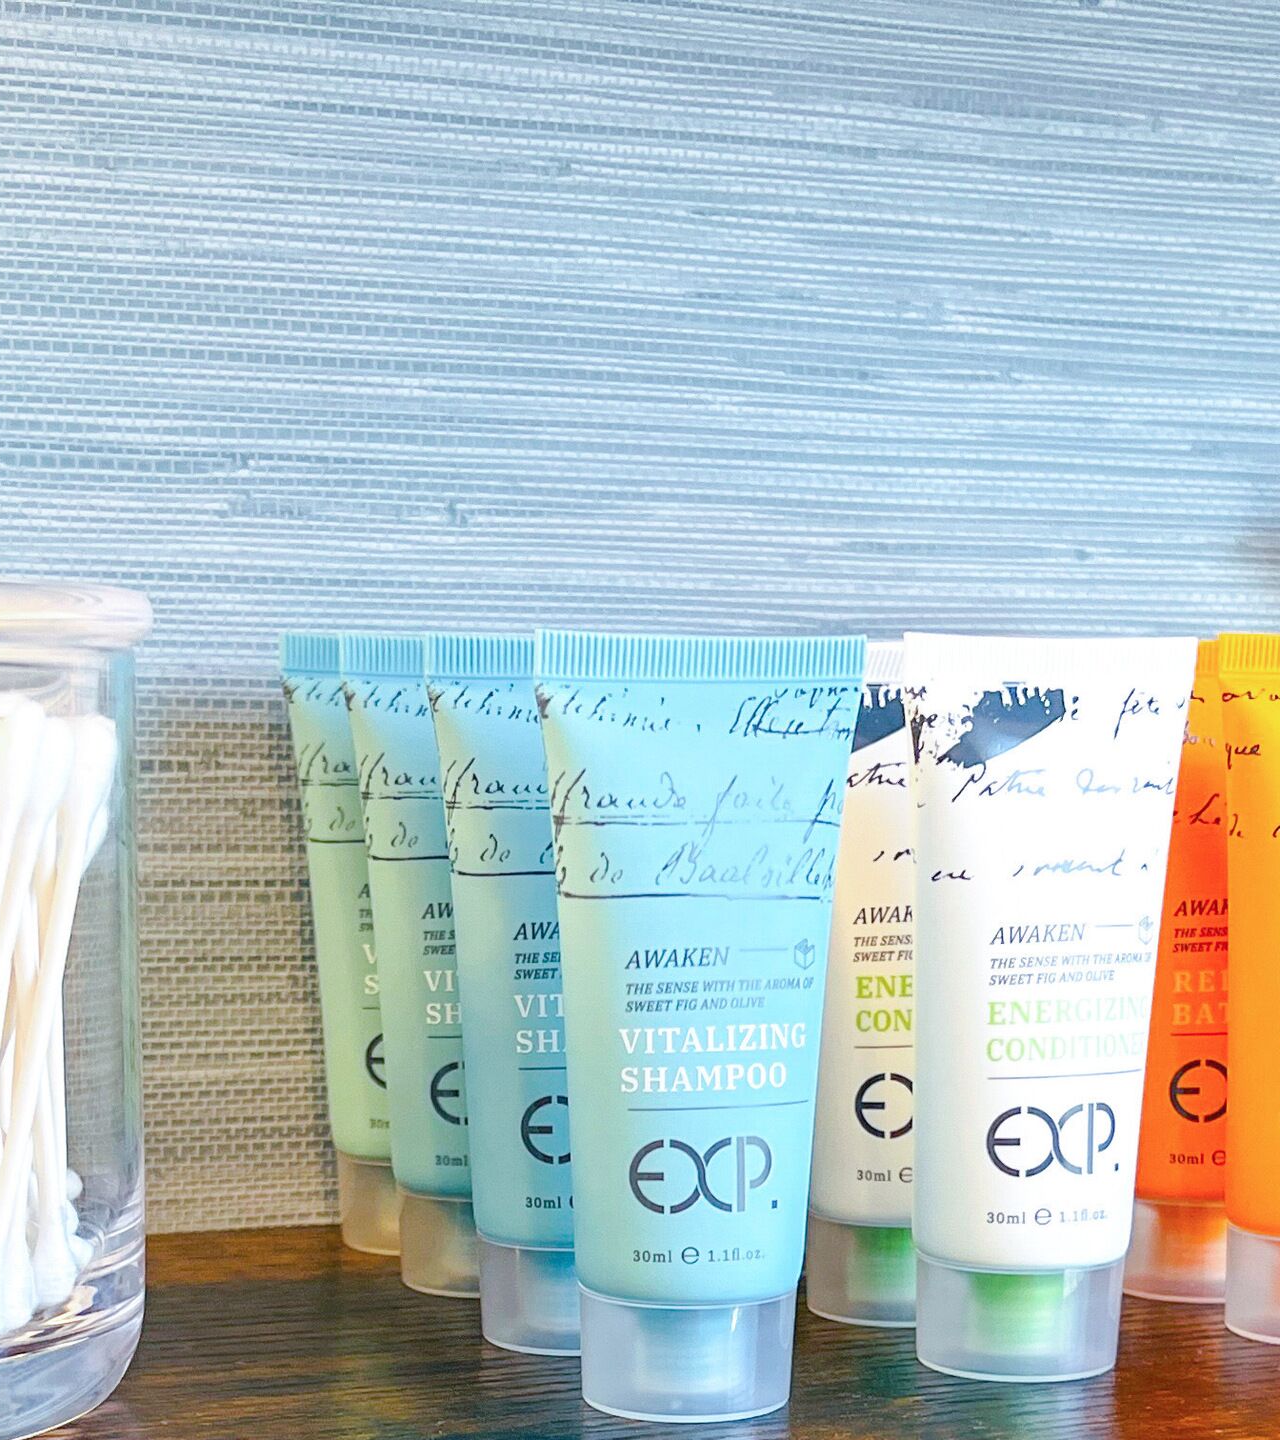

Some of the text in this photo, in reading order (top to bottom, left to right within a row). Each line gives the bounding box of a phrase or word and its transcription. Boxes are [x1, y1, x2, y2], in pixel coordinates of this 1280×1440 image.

[1174, 898, 1228, 917] AWAK
[853, 905, 913, 925] AWAK
[989, 923, 1085, 945] AWAKEN
[1199, 926, 1228, 938] SENS
[854, 934, 913, 947] THE SENS
[423, 944, 456, 956] SWEE
[853, 950, 901, 962] SWEET
[514, 953, 539, 964] THE
[624, 946, 730, 970] AWAKEN
[990, 957, 1016, 969] THE
[1018, 956, 1058, 968] SENSE
[1061, 954, 1091, 967] WITH
[1093, 953, 1112, 966] THE
[514, 968, 554, 980] SWEET
[989, 969, 1115, 986] SWEET FIG AND OLIVE
[625, 976, 815, 995] THE SENSE WITH THE AROMA OF
[625, 996, 766, 1013] SWEET FIG AND OLIVE
[619, 1023, 807, 1055] VITALIZING
[985, 1032, 1146, 1063] CONDITIONE
[621, 1061, 787, 1093] SHAMPOO
[1169, 1153, 1204, 1165] 30ml
[856, 1169, 891, 1182] 30ml
[525, 1197, 561, 1209] 30ml
[987, 1211, 1026, 1224] 30ml
[633, 1250, 672, 1263] 30ml
